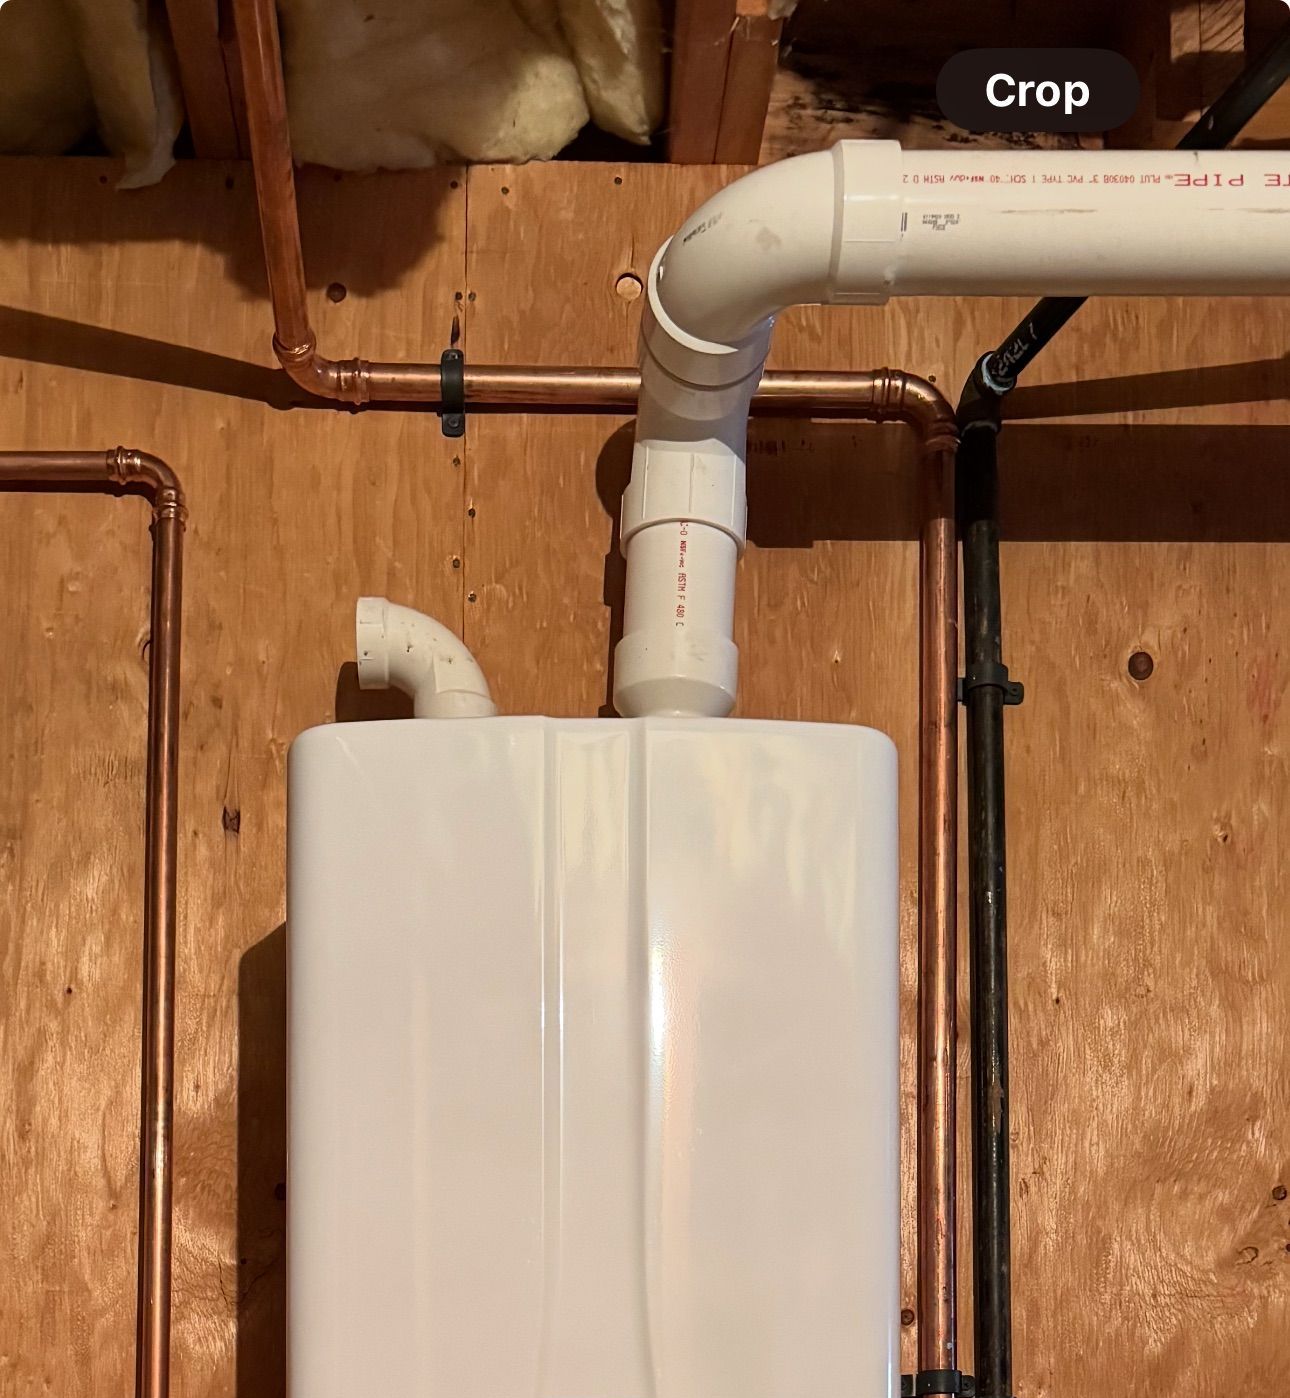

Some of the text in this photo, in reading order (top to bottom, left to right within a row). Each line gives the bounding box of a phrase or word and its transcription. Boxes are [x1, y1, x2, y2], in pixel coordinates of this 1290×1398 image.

[989, 176, 1001, 186] 40
[1042, 176, 1062, 186] TYPE
[1067, 176, 1084, 186] PVC
[1174, 174, 1243, 187] PIPE
[677, 572, 687, 592] ASTM
[676, 604, 685, 618] 480
